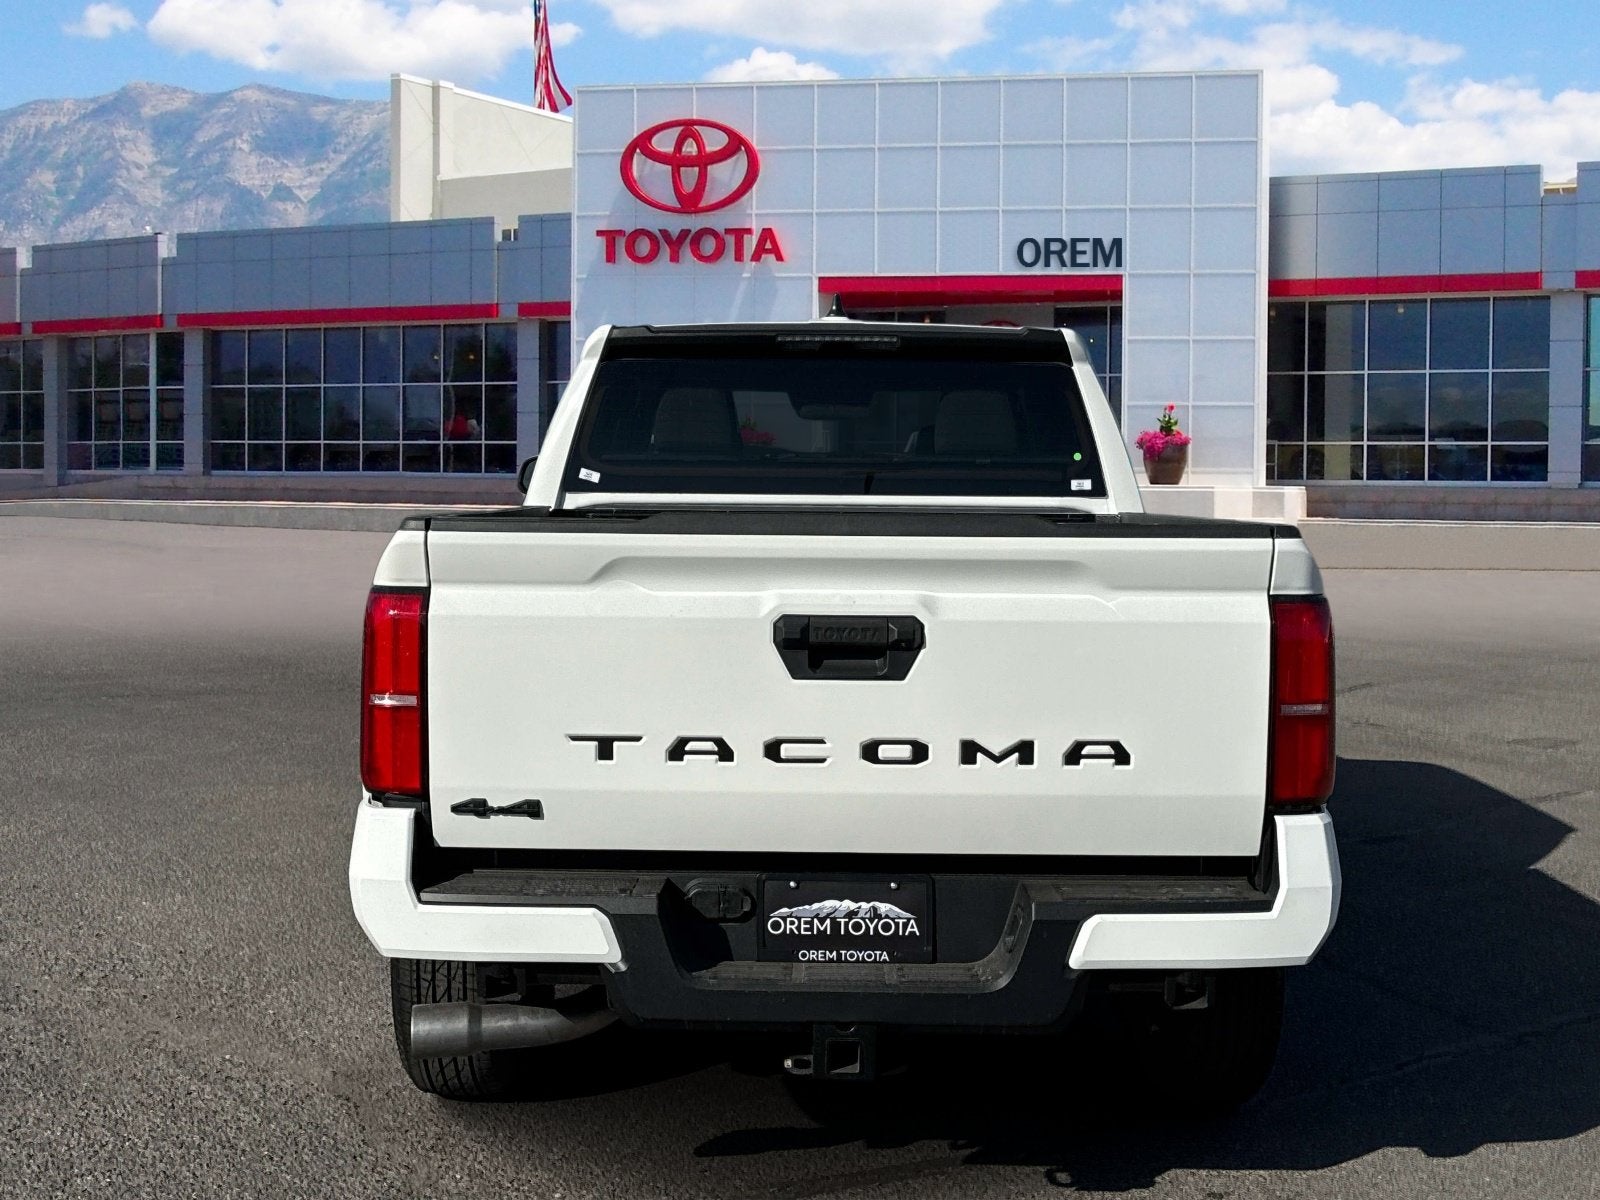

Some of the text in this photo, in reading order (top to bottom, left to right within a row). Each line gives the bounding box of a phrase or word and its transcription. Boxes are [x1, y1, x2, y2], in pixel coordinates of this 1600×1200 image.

[596, 227, 785, 265] TOYOTA
[1016, 237, 1123, 268] OREM
[813, 626, 883, 641] TOYOTA
[565, 734, 1134, 769] TACOMA
[766, 917, 920, 937] OREM TOYOTA
[798, 950, 890, 963] OREM TOYOTA
